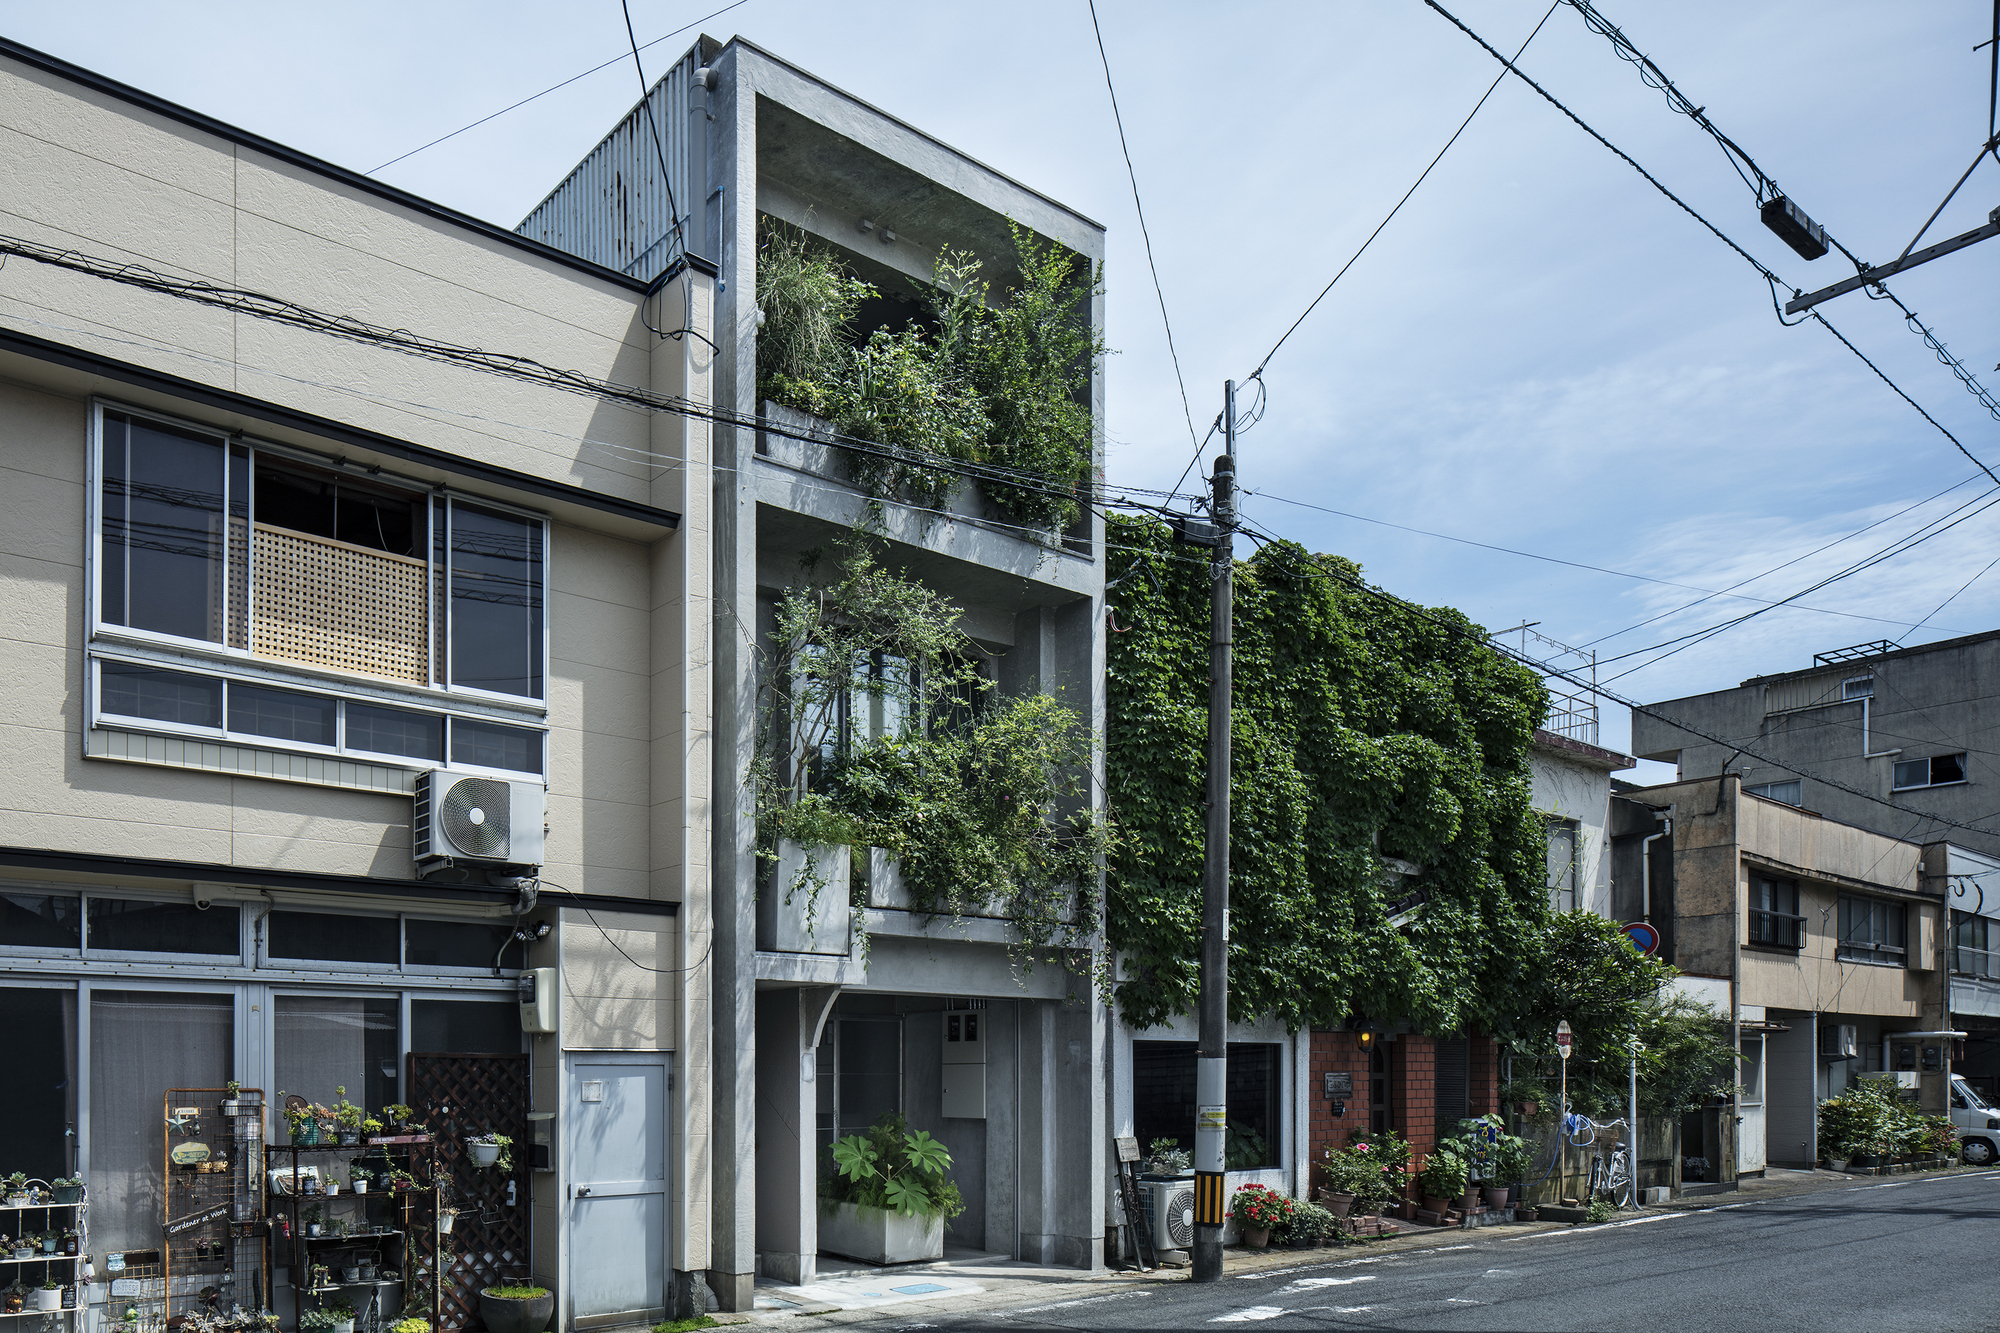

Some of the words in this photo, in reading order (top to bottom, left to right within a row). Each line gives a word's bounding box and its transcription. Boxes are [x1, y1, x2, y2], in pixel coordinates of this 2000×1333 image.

[169, 1218, 200, 1233] Gardener
[201, 1214, 209, 1222] at
[210, 1208, 227, 1218] Work
